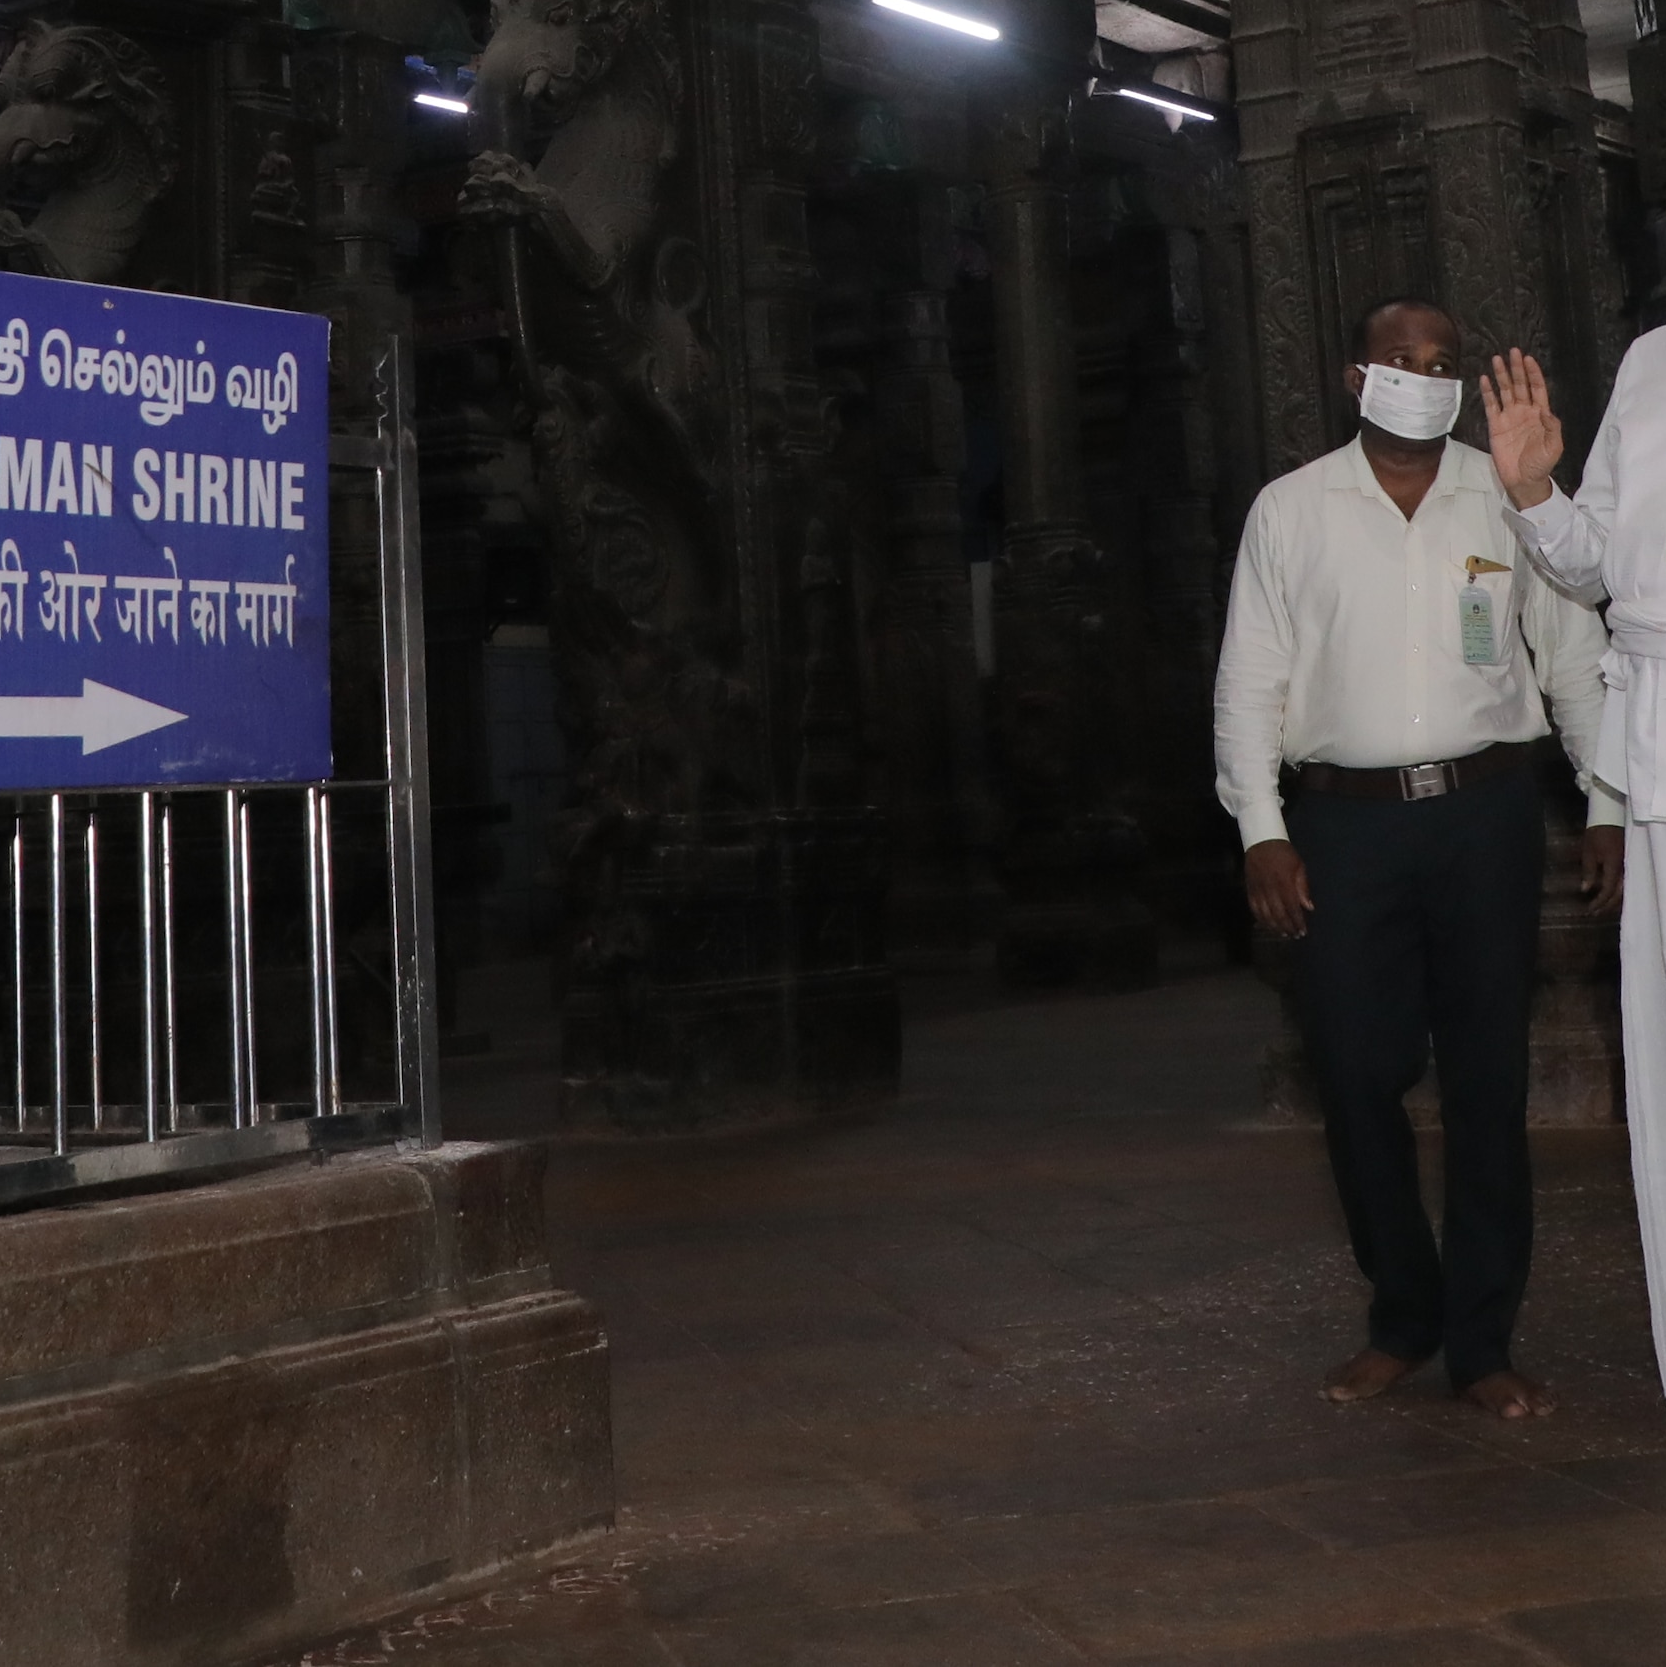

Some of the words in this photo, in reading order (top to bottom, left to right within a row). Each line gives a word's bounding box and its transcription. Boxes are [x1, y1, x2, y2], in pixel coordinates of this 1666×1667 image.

[40, 328, 215, 425] செல்லும்
[226, 351, 298, 434] வழி
[132, 446, 306, 531] SHRINE
[38, 540, 107, 646] ओर
[113, 546, 182, 645] जाने
[189, 578, 230, 647] का
[236, 553, 299, 648] मार्ग
